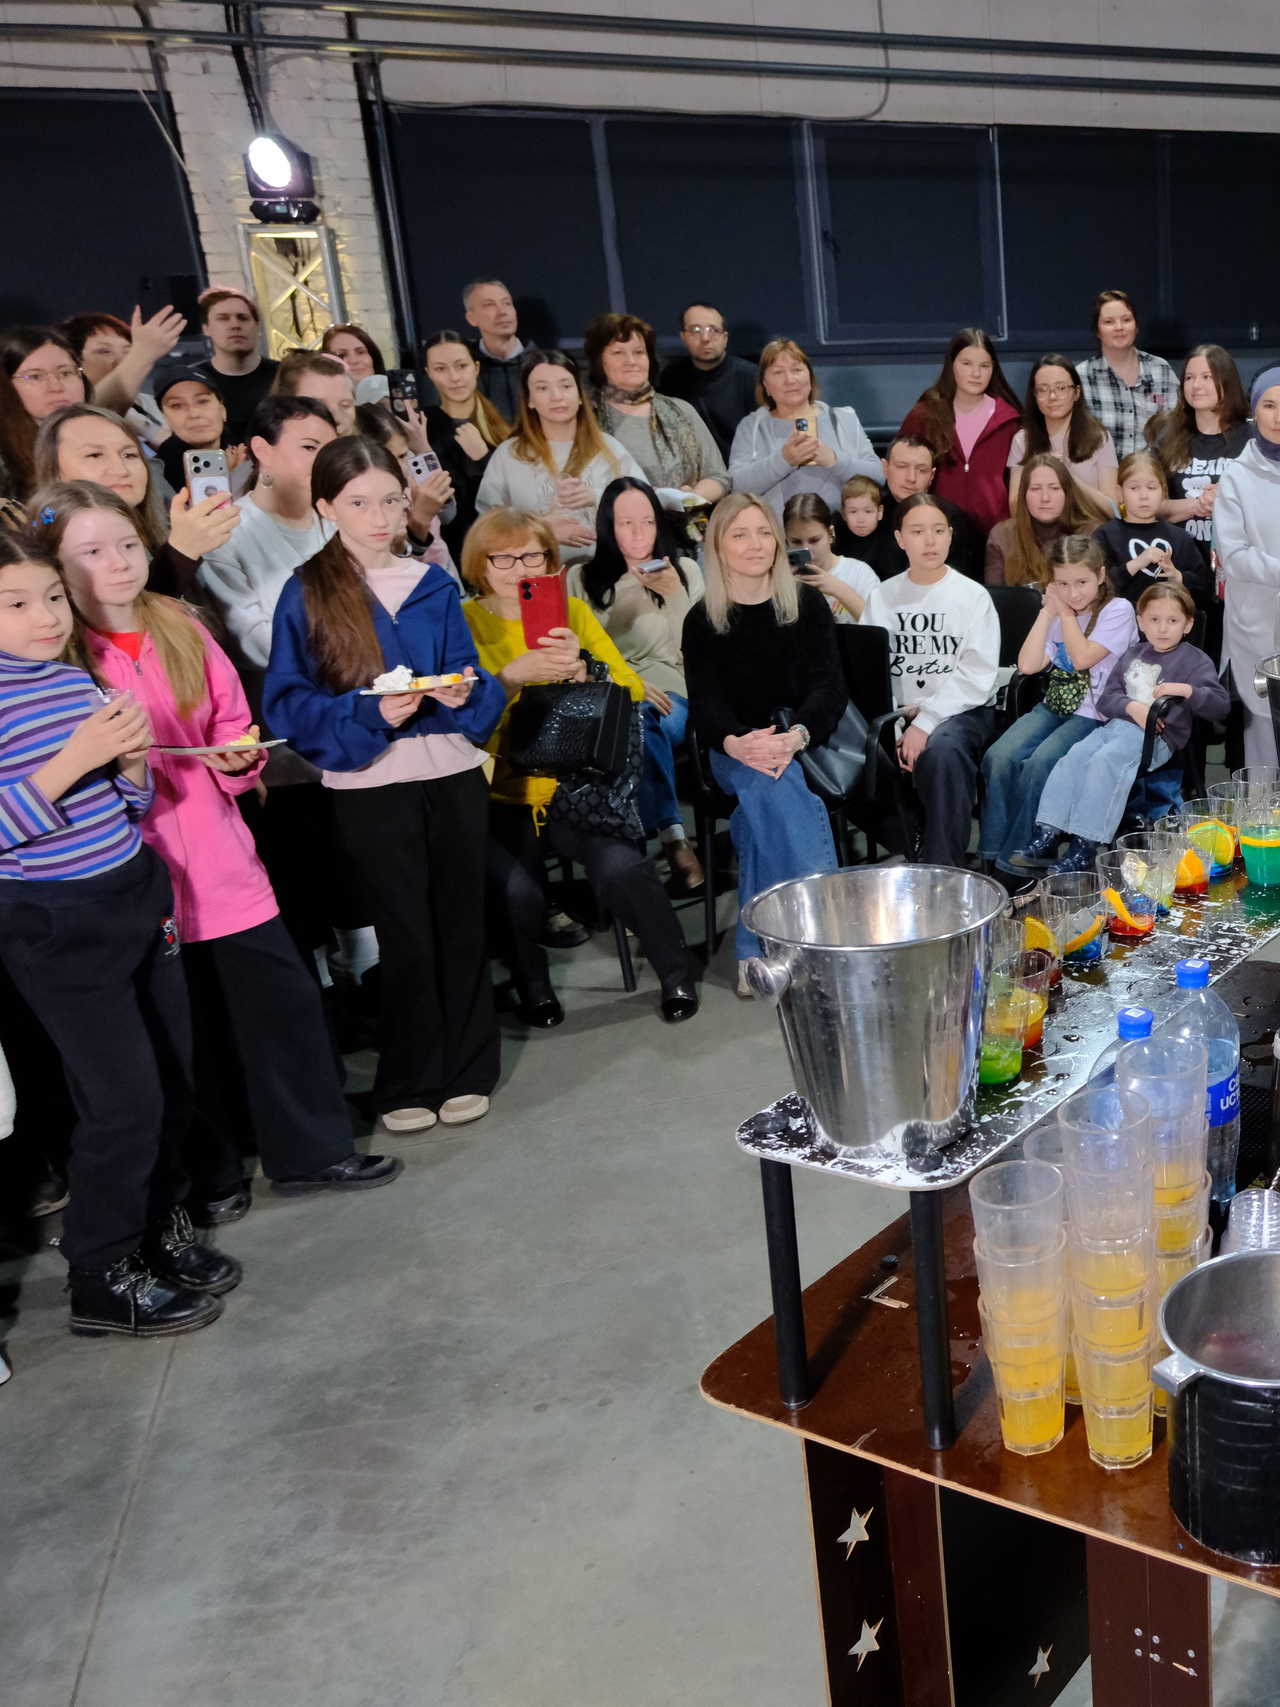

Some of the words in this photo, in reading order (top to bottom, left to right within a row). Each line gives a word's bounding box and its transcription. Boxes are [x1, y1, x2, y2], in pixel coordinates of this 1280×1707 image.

[895, 612, 946, 632] YOU
[890, 634, 926, 655] RE
[929, 634, 964, 656] MY
[890, 655, 953, 677] Bestie
